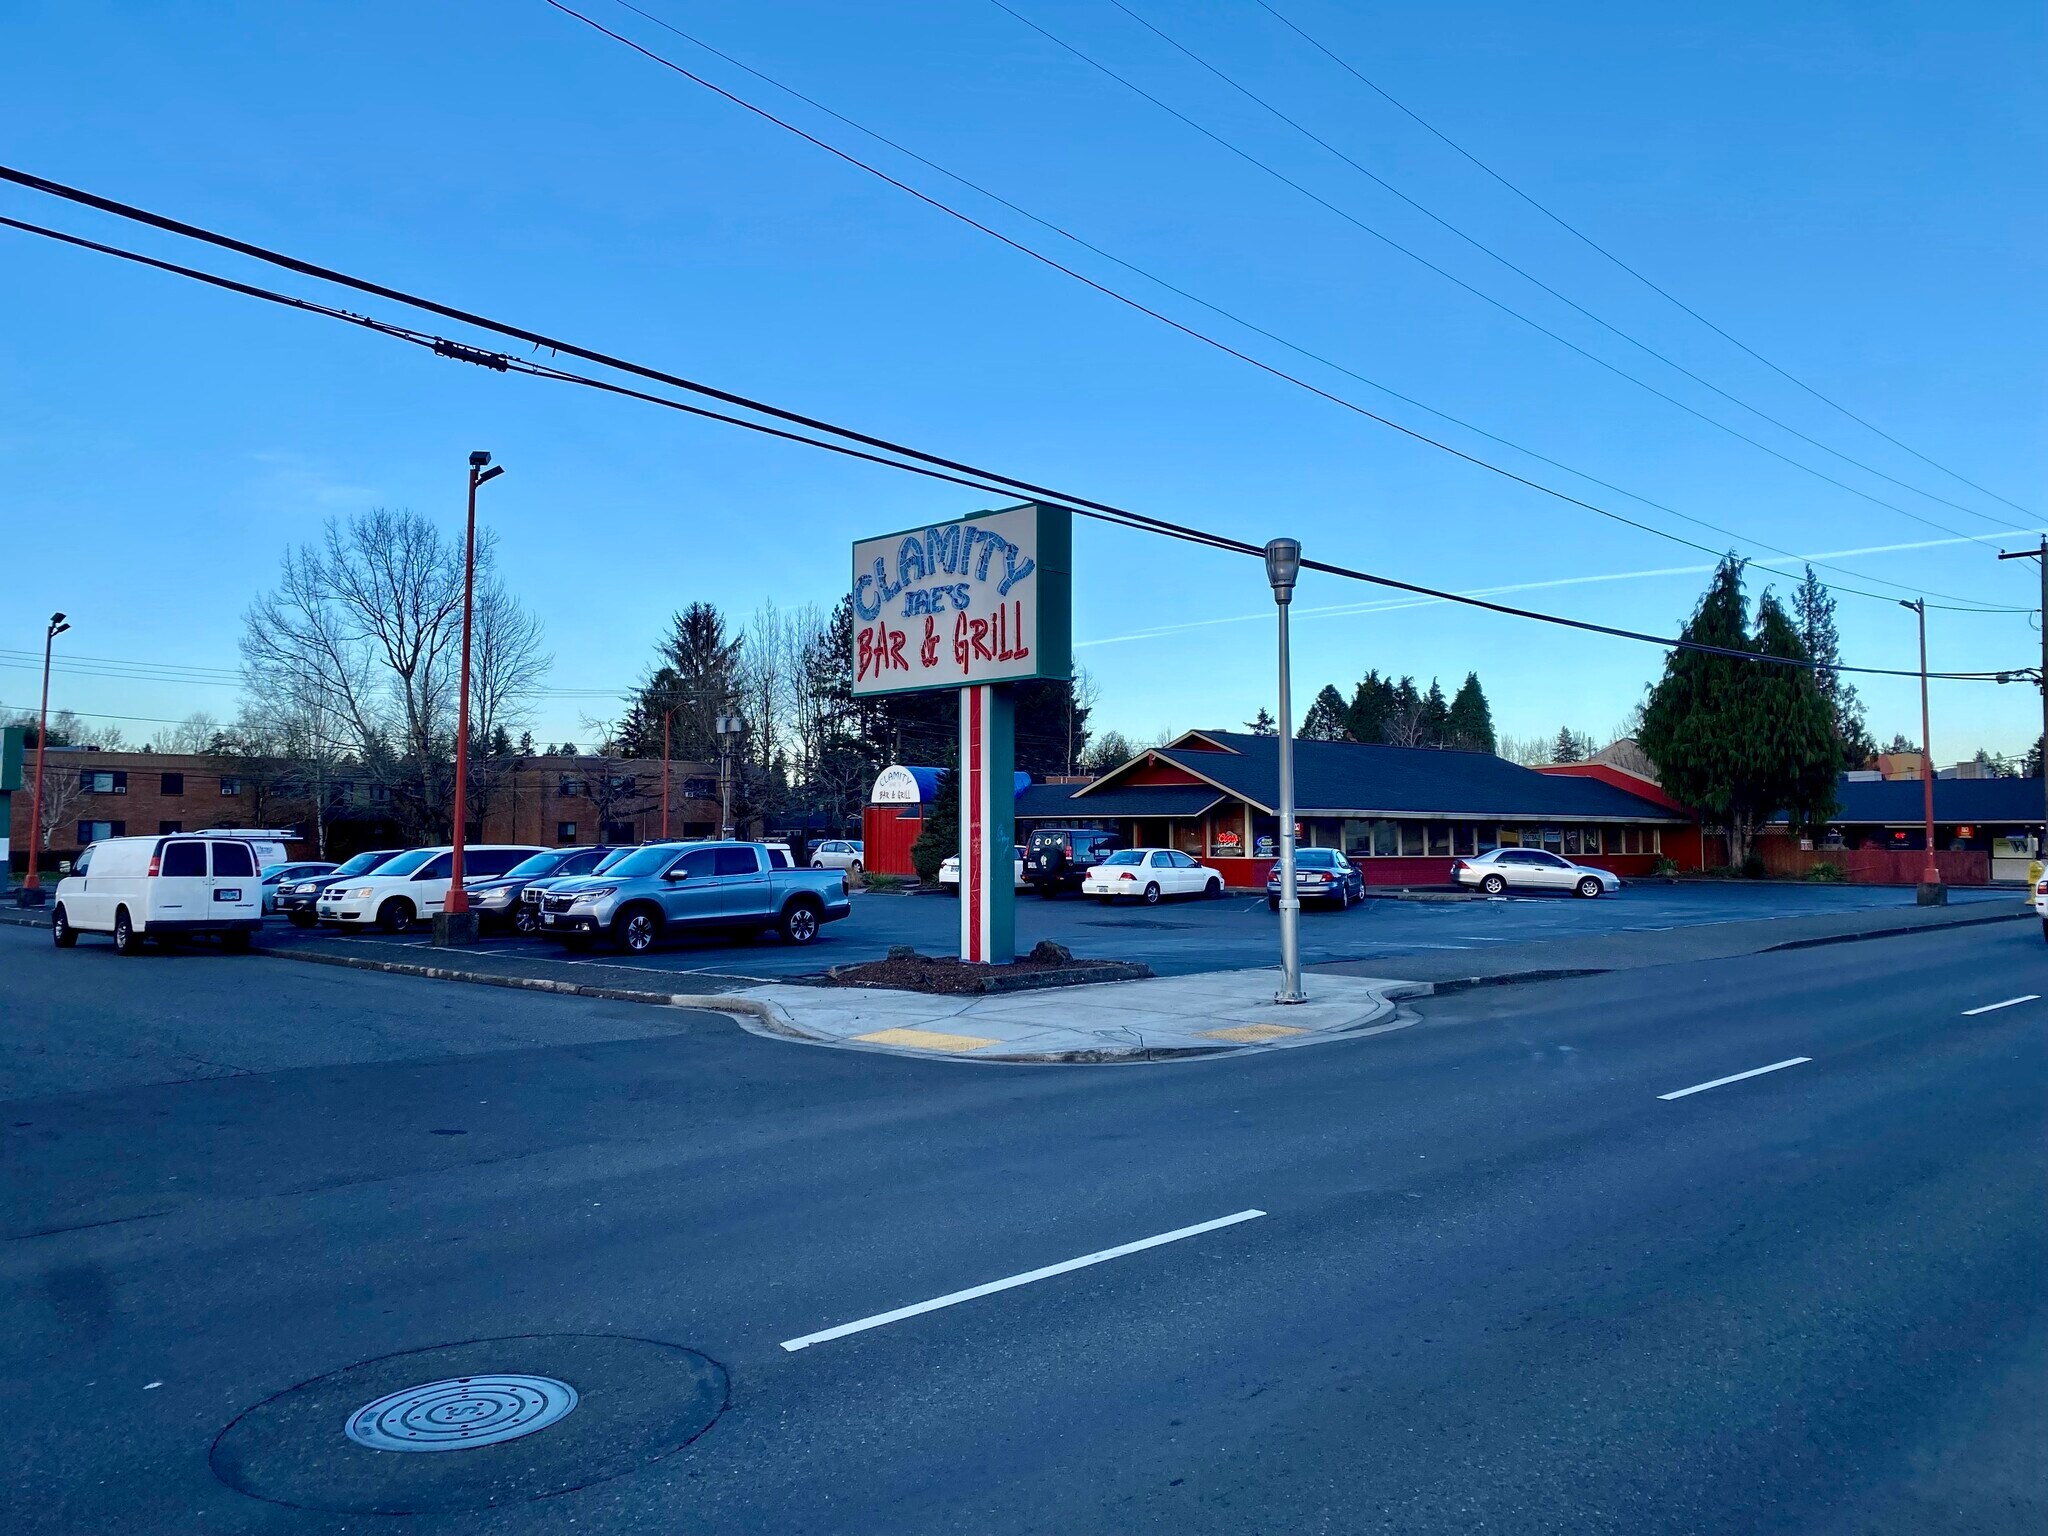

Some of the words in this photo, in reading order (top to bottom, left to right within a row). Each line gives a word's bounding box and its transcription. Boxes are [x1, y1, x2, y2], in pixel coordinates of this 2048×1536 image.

[854, 524, 1036, 621] CLAMITY
[856, 621, 909, 682] BAR
[921, 615, 940, 668] &
[879, 790, 890, 800] BAR
[880, 771, 912, 787] CLAMITY
